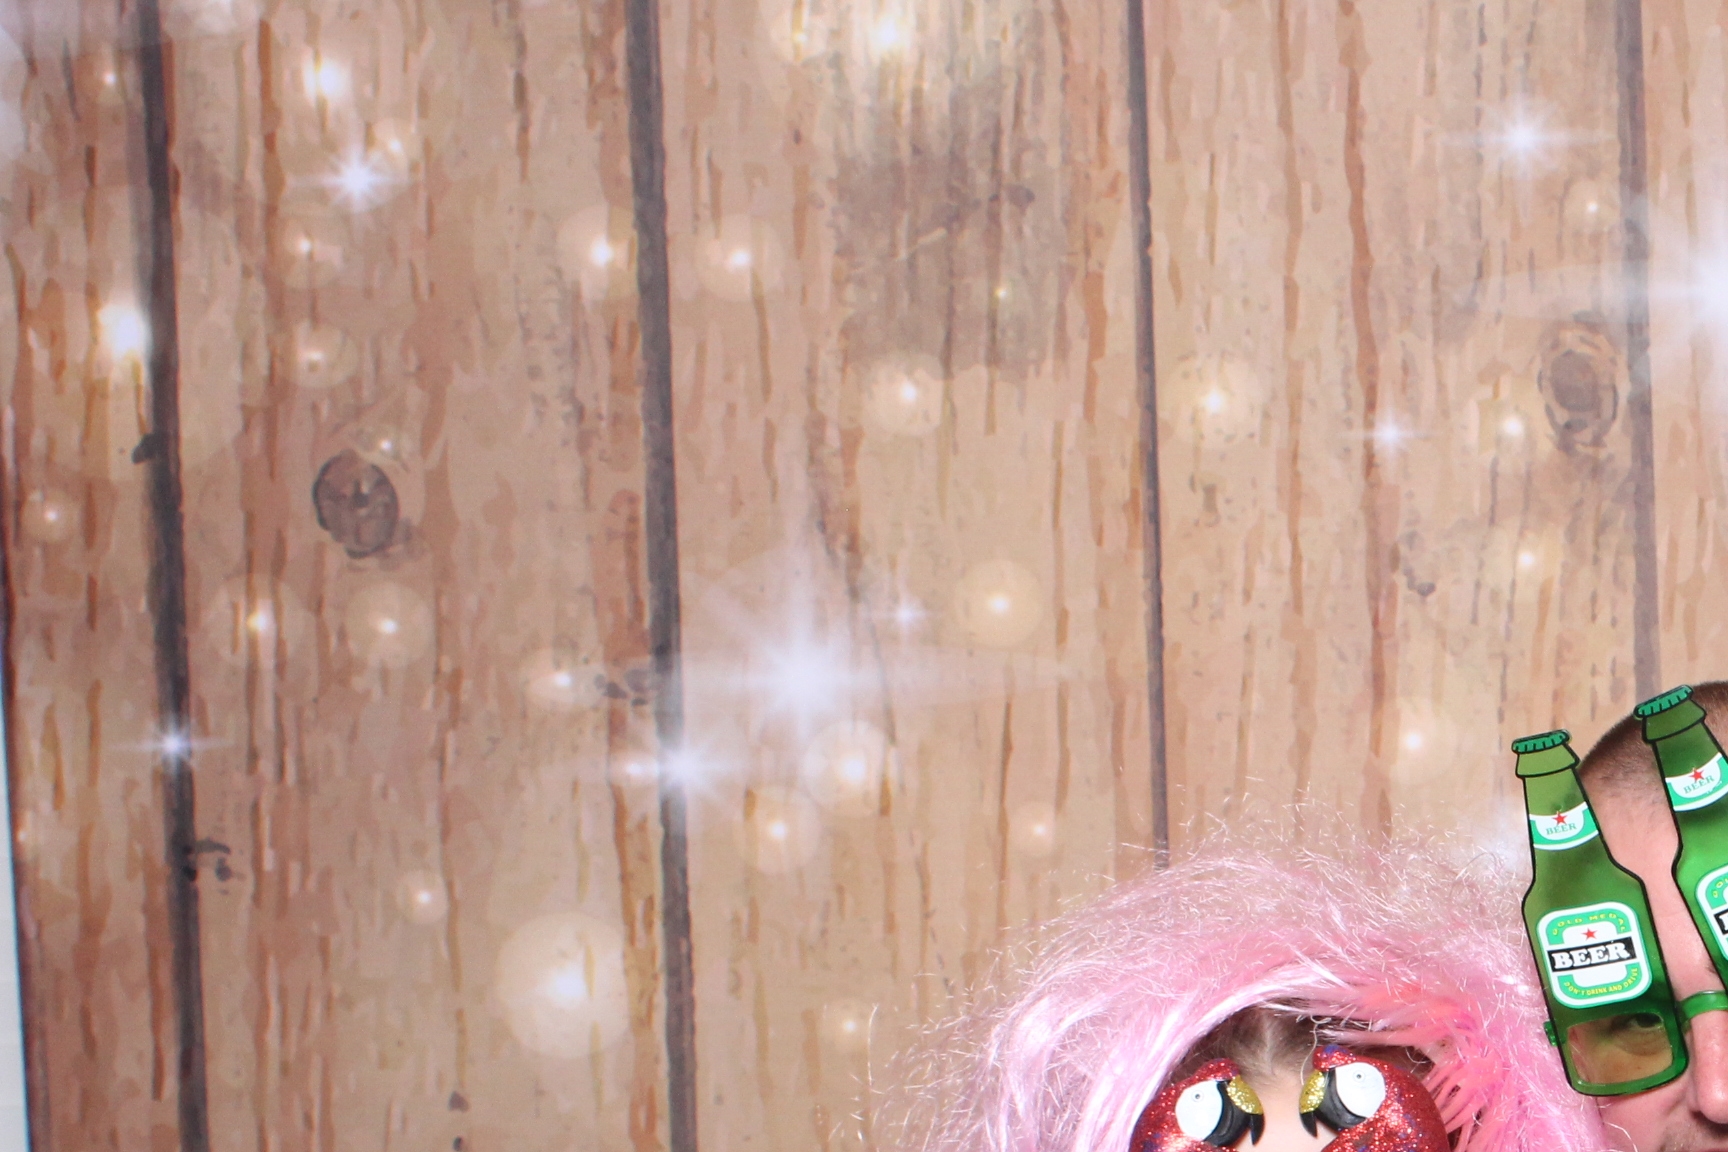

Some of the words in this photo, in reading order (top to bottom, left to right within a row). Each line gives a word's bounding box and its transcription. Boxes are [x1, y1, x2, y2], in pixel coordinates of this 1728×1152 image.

[1683, 775, 1715, 794] BEER
[1546, 823, 1577, 835] BEER
[1552, 918, 1583, 936] GOLD
[1589, 913, 1626, 931] MEDAL
[1551, 942, 1631, 969] BEER
[1564, 981, 1585, 995] DON'T
[1587, 987, 1607, 995] DRINK
[1609, 984, 1622, 992] AND
[1623, 968, 1638, 987] DRIVE
